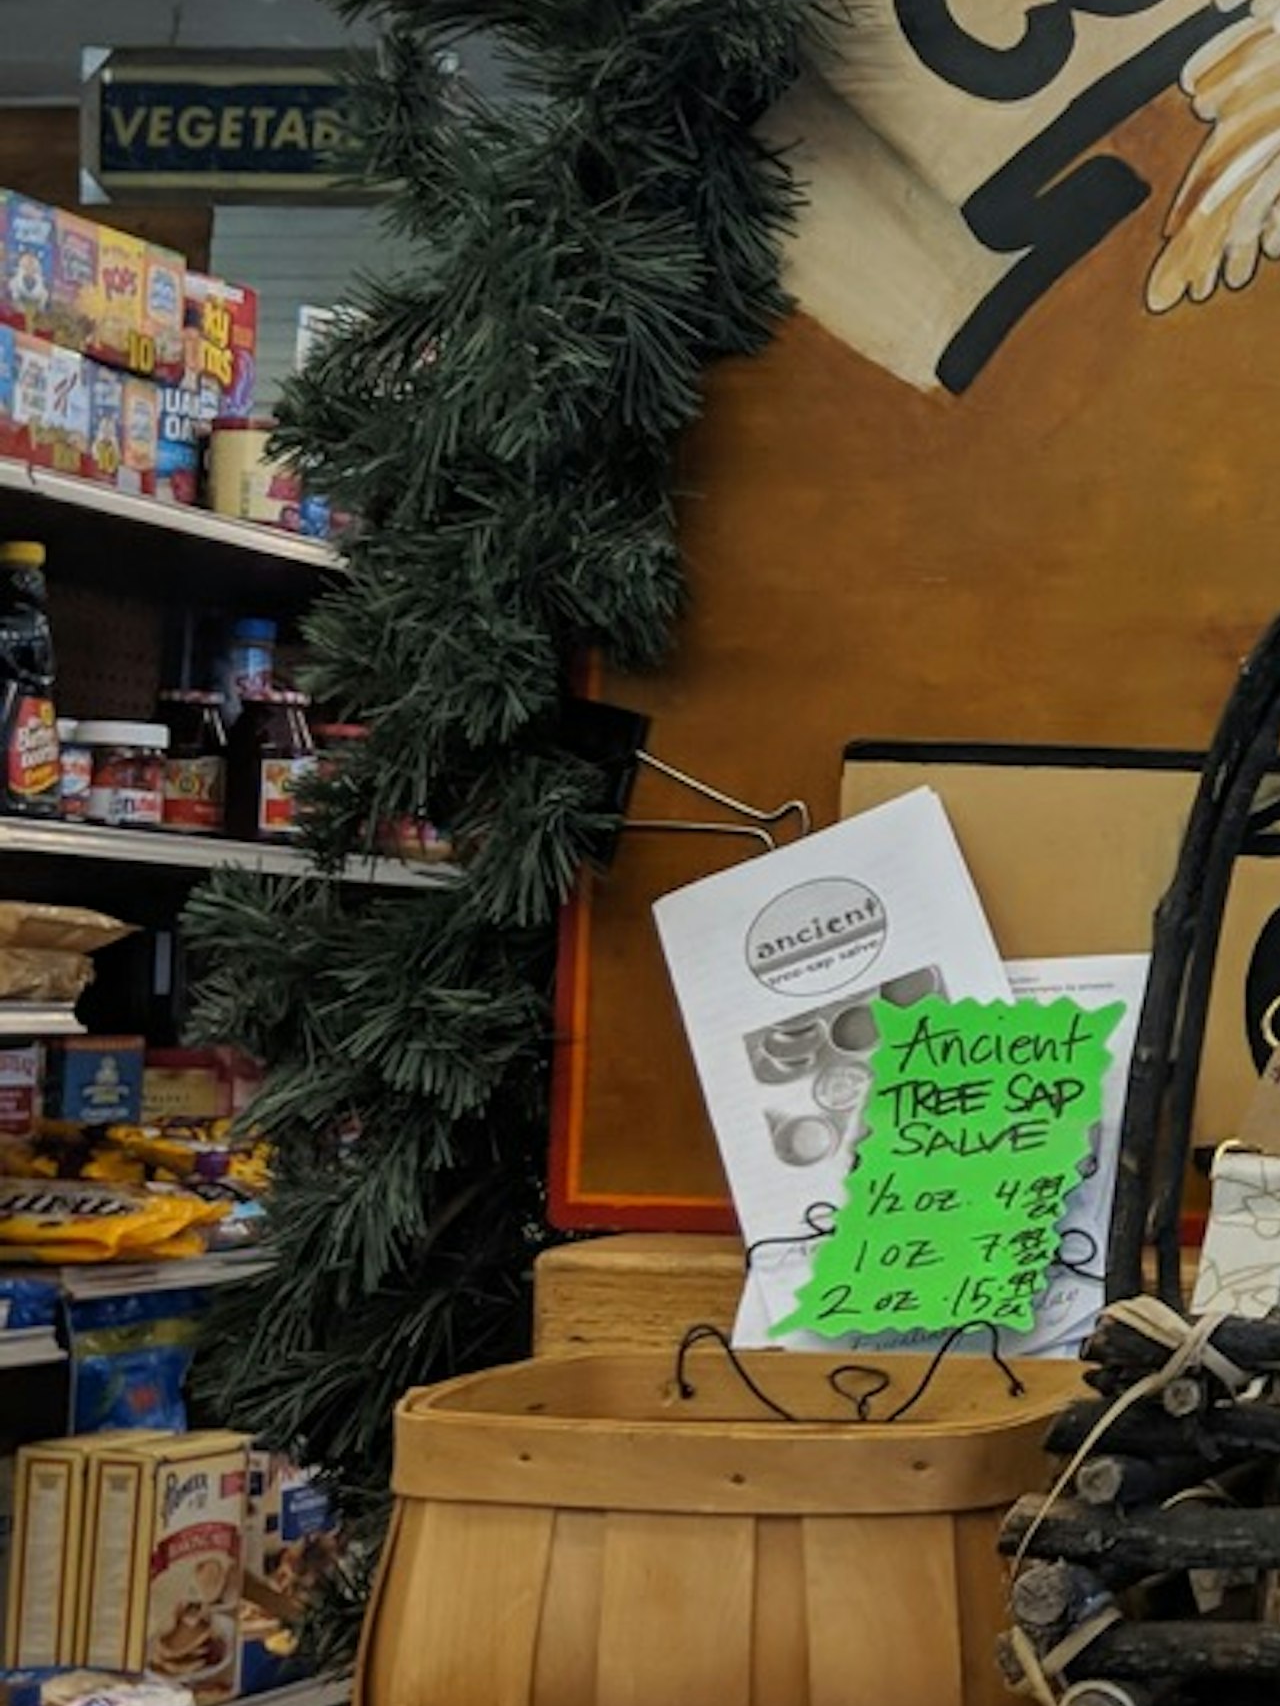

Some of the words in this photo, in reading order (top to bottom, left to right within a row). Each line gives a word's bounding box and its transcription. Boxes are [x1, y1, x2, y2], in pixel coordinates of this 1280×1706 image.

[110, 105, 363, 151] VEGETAB
[755, 897, 877, 959] ancient
[891, 1013, 1093, 1073] Ancient
[877, 1078, 994, 1127] TREE
[1004, 1073, 1086, 1119] SAP
[891, 1119, 1049, 1157] SALVE
[817, 1284, 860, 1320] 2
